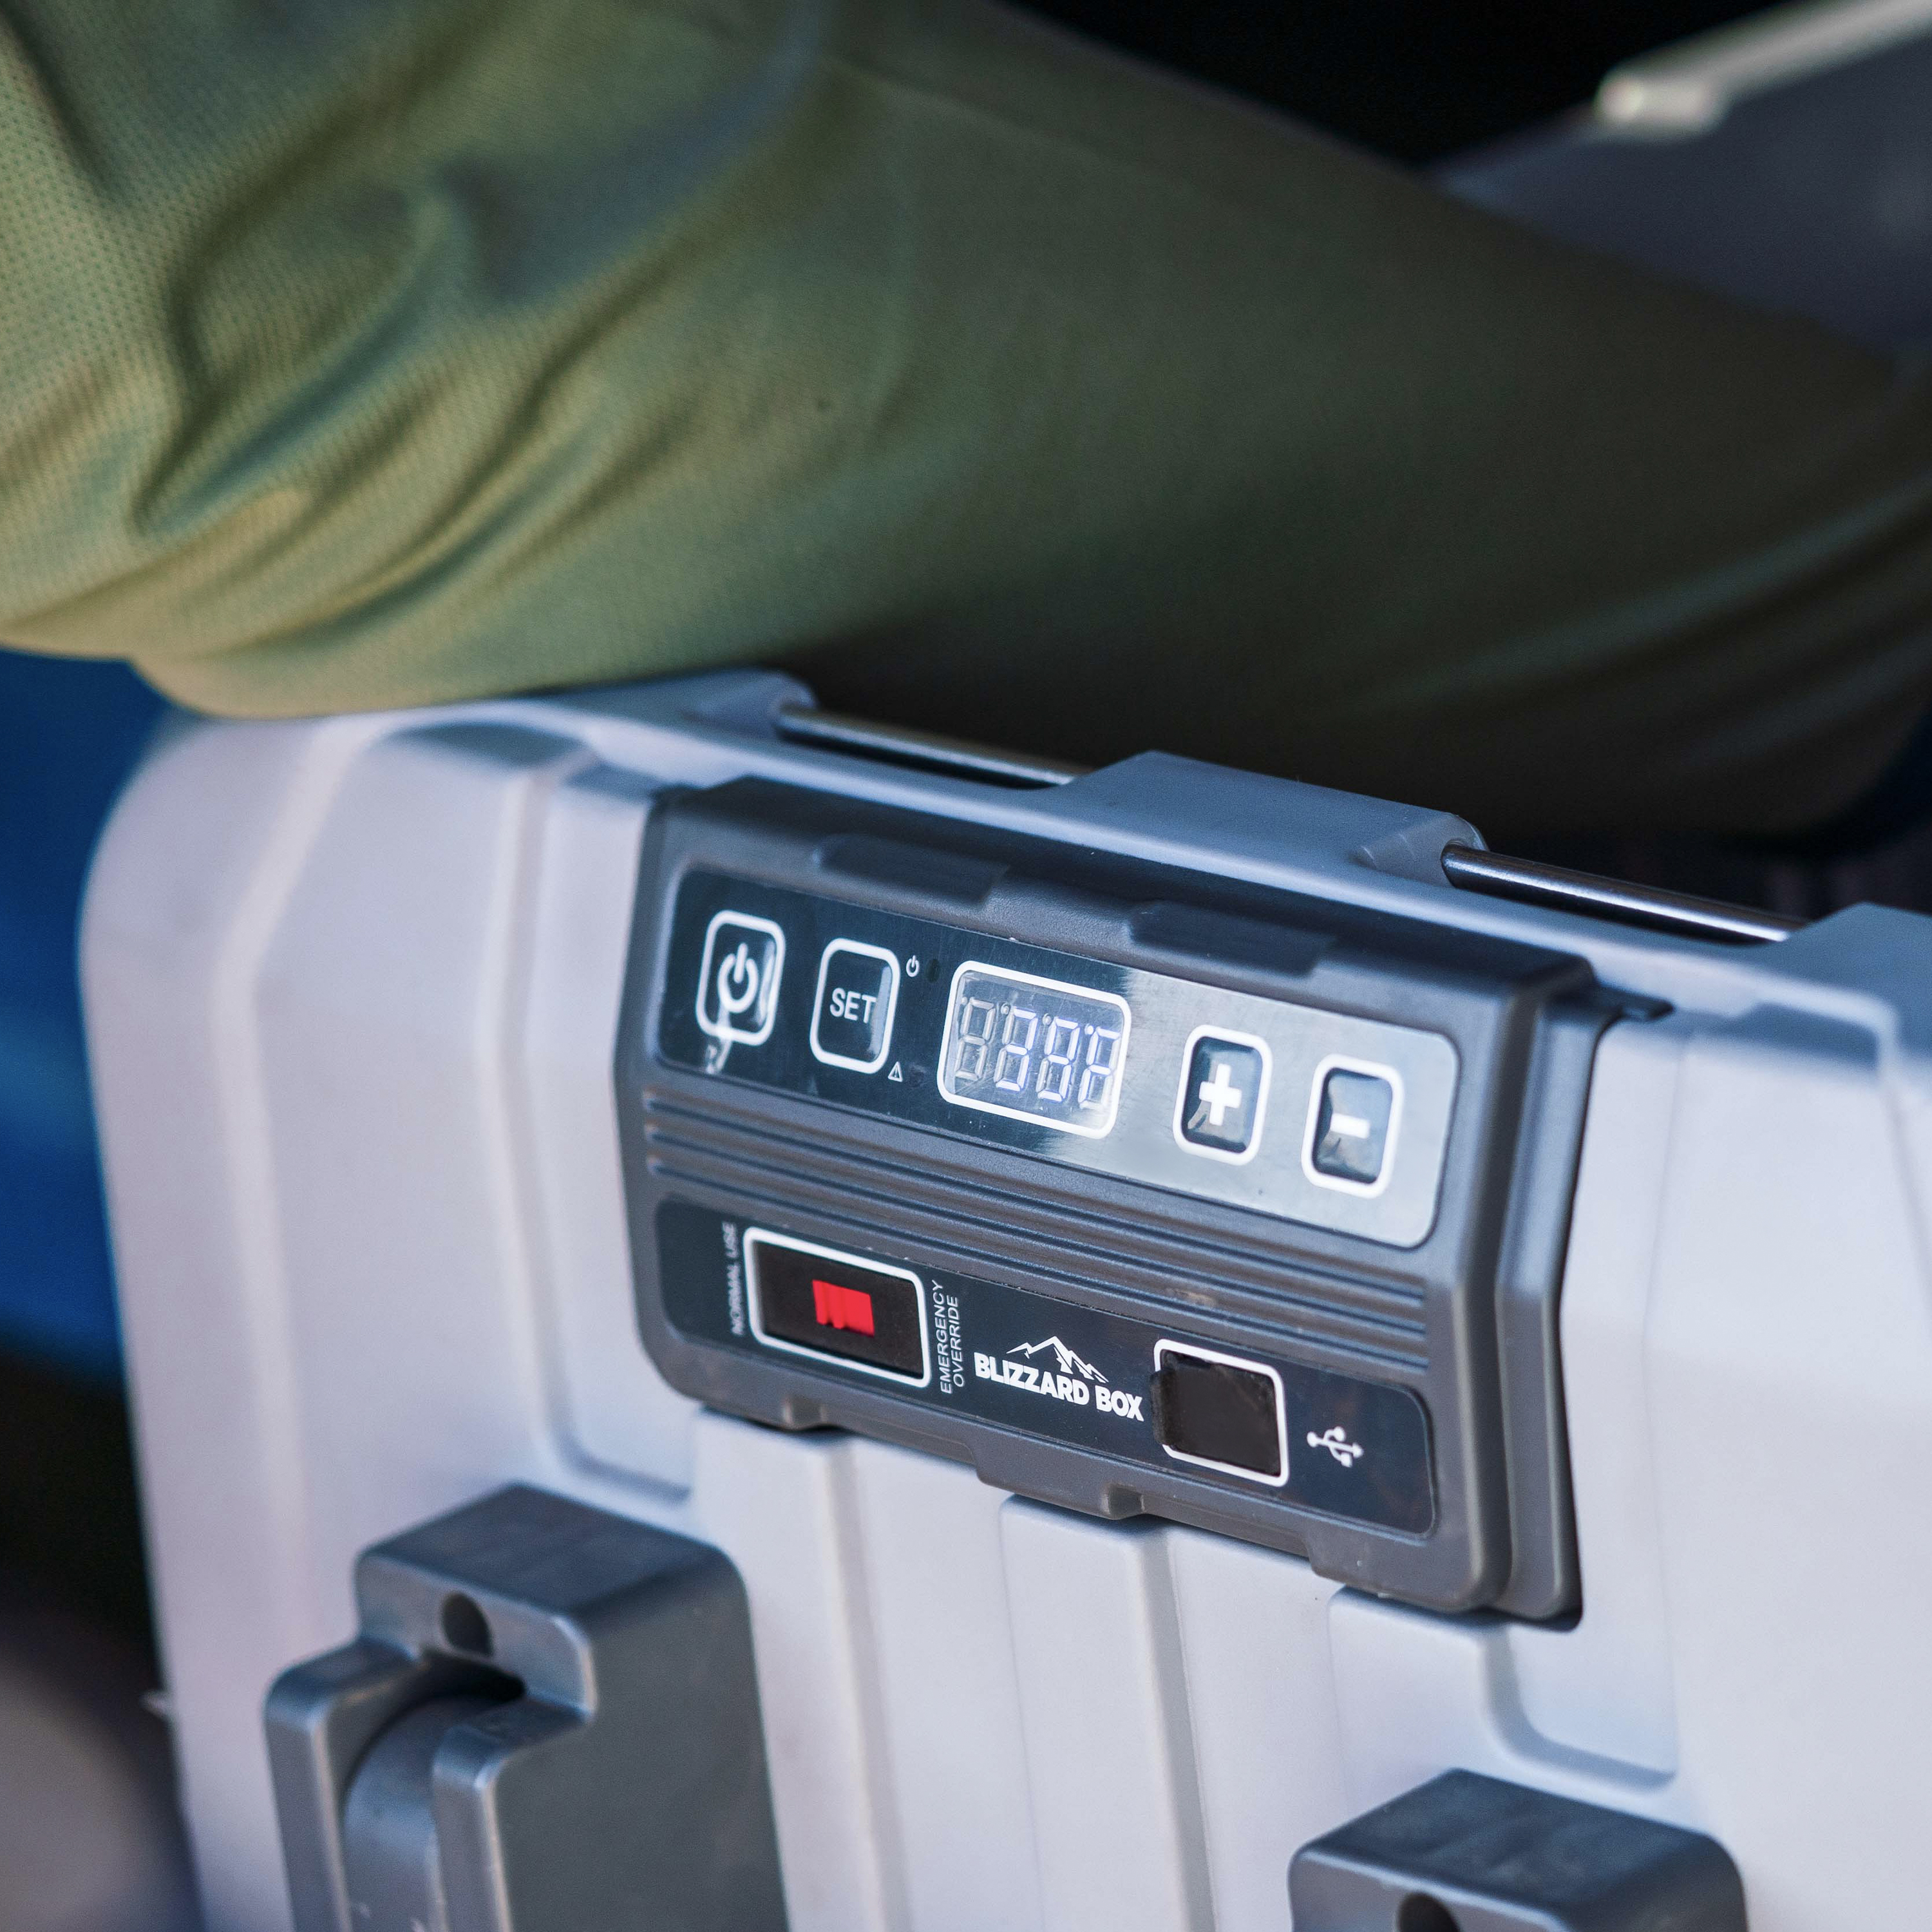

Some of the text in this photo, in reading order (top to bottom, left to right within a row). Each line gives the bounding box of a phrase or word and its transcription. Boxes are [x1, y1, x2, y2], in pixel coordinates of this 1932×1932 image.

[830, 988, 876, 1023] SET
[723, 1223, 737, 1258] USE
[933, 1280, 952, 1394] EMERGENCY
[947, 1295, 965, 1387] OVERRIDE
[975, 1352, 1144, 1421] BLIZZARD BOX
